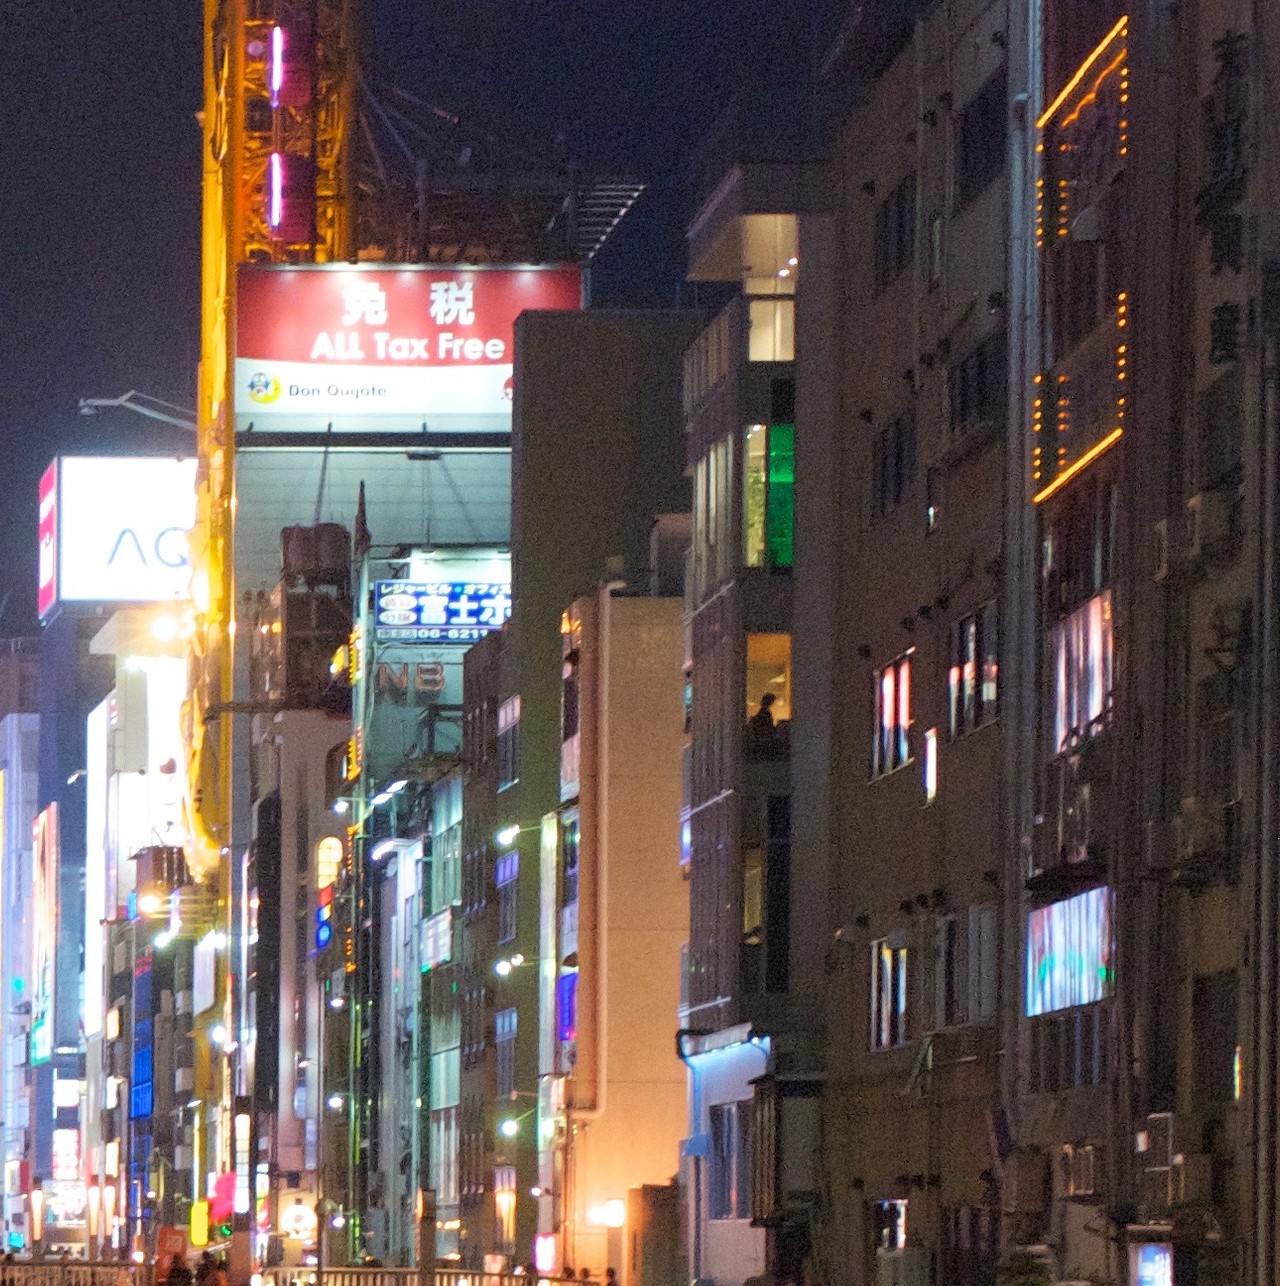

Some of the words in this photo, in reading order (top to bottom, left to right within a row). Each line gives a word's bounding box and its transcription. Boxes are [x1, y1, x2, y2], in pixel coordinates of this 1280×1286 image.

[342, 280, 475, 325] 免税
[311, 332, 364, 360] ALL
[374, 332, 429, 360] Tax
[438, 332, 505, 360] Free
[289, 384, 321, 397] Don
[327, 384, 387, 399] Quijote
